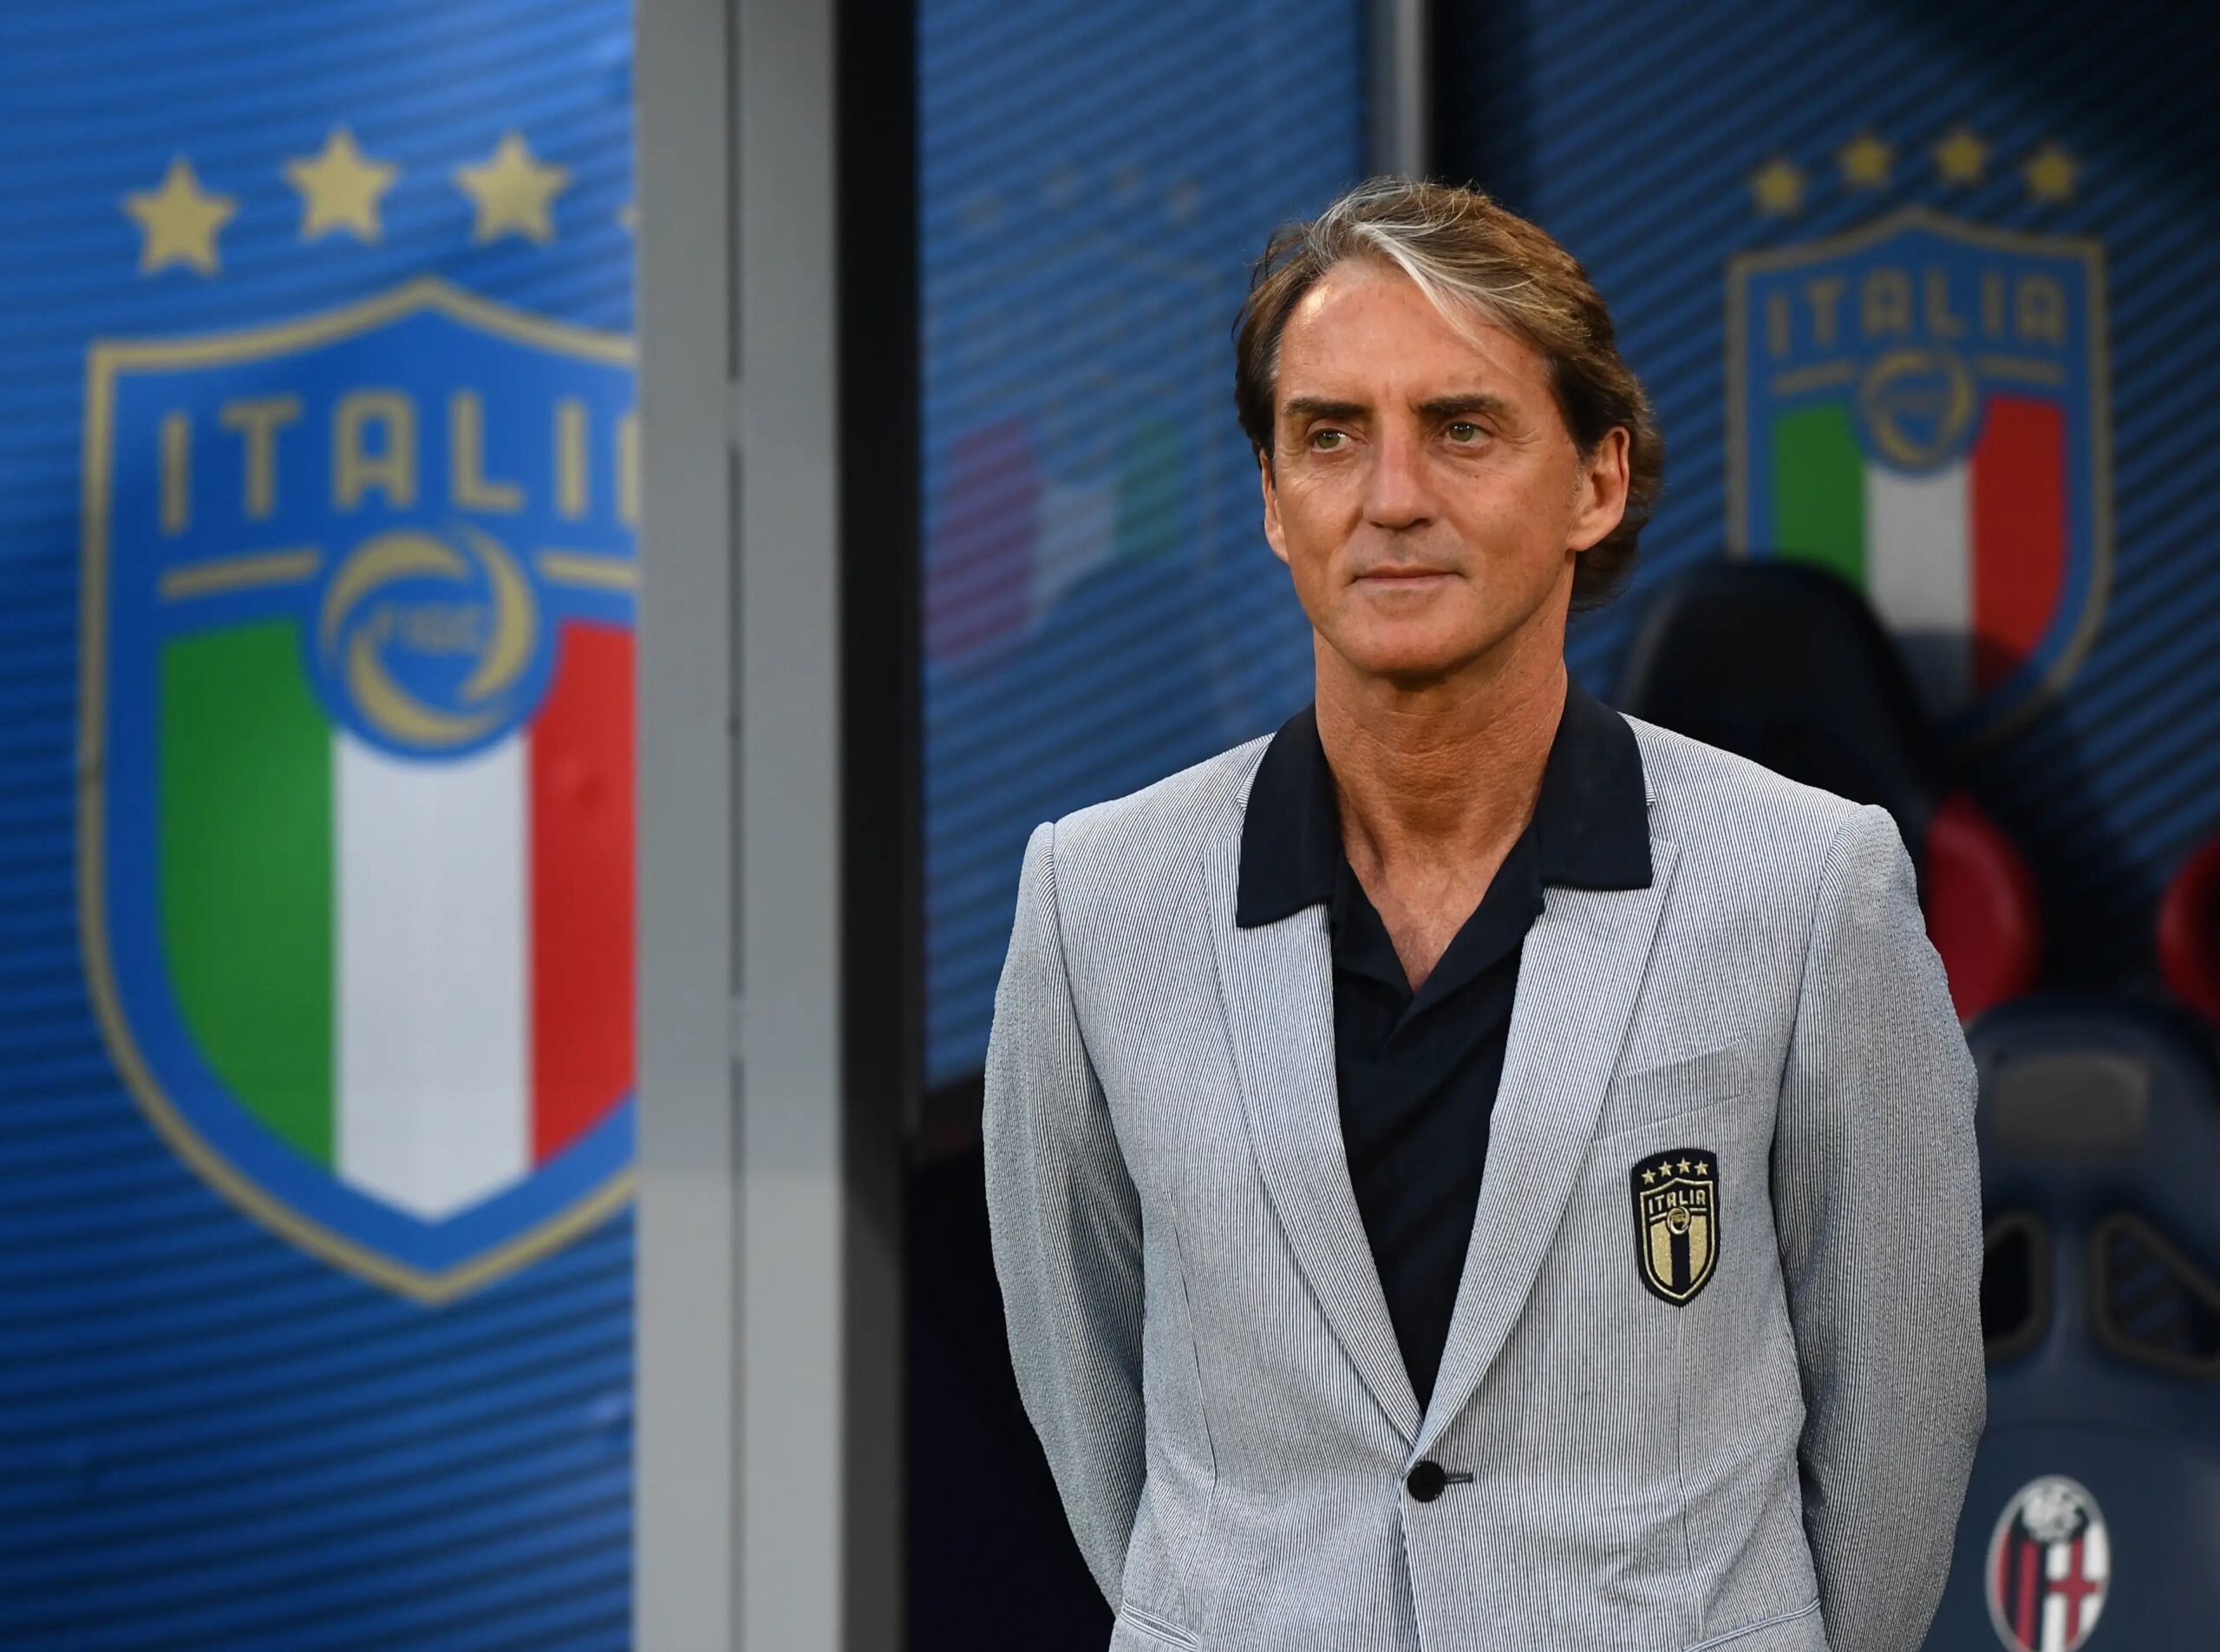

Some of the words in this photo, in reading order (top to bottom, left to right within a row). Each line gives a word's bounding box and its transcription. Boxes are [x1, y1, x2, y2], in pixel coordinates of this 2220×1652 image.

[1768, 269, 2065, 355] ITALIA
[162, 390, 638, 532] ITALI
[1649, 1189, 1707, 1214] ITALIA
